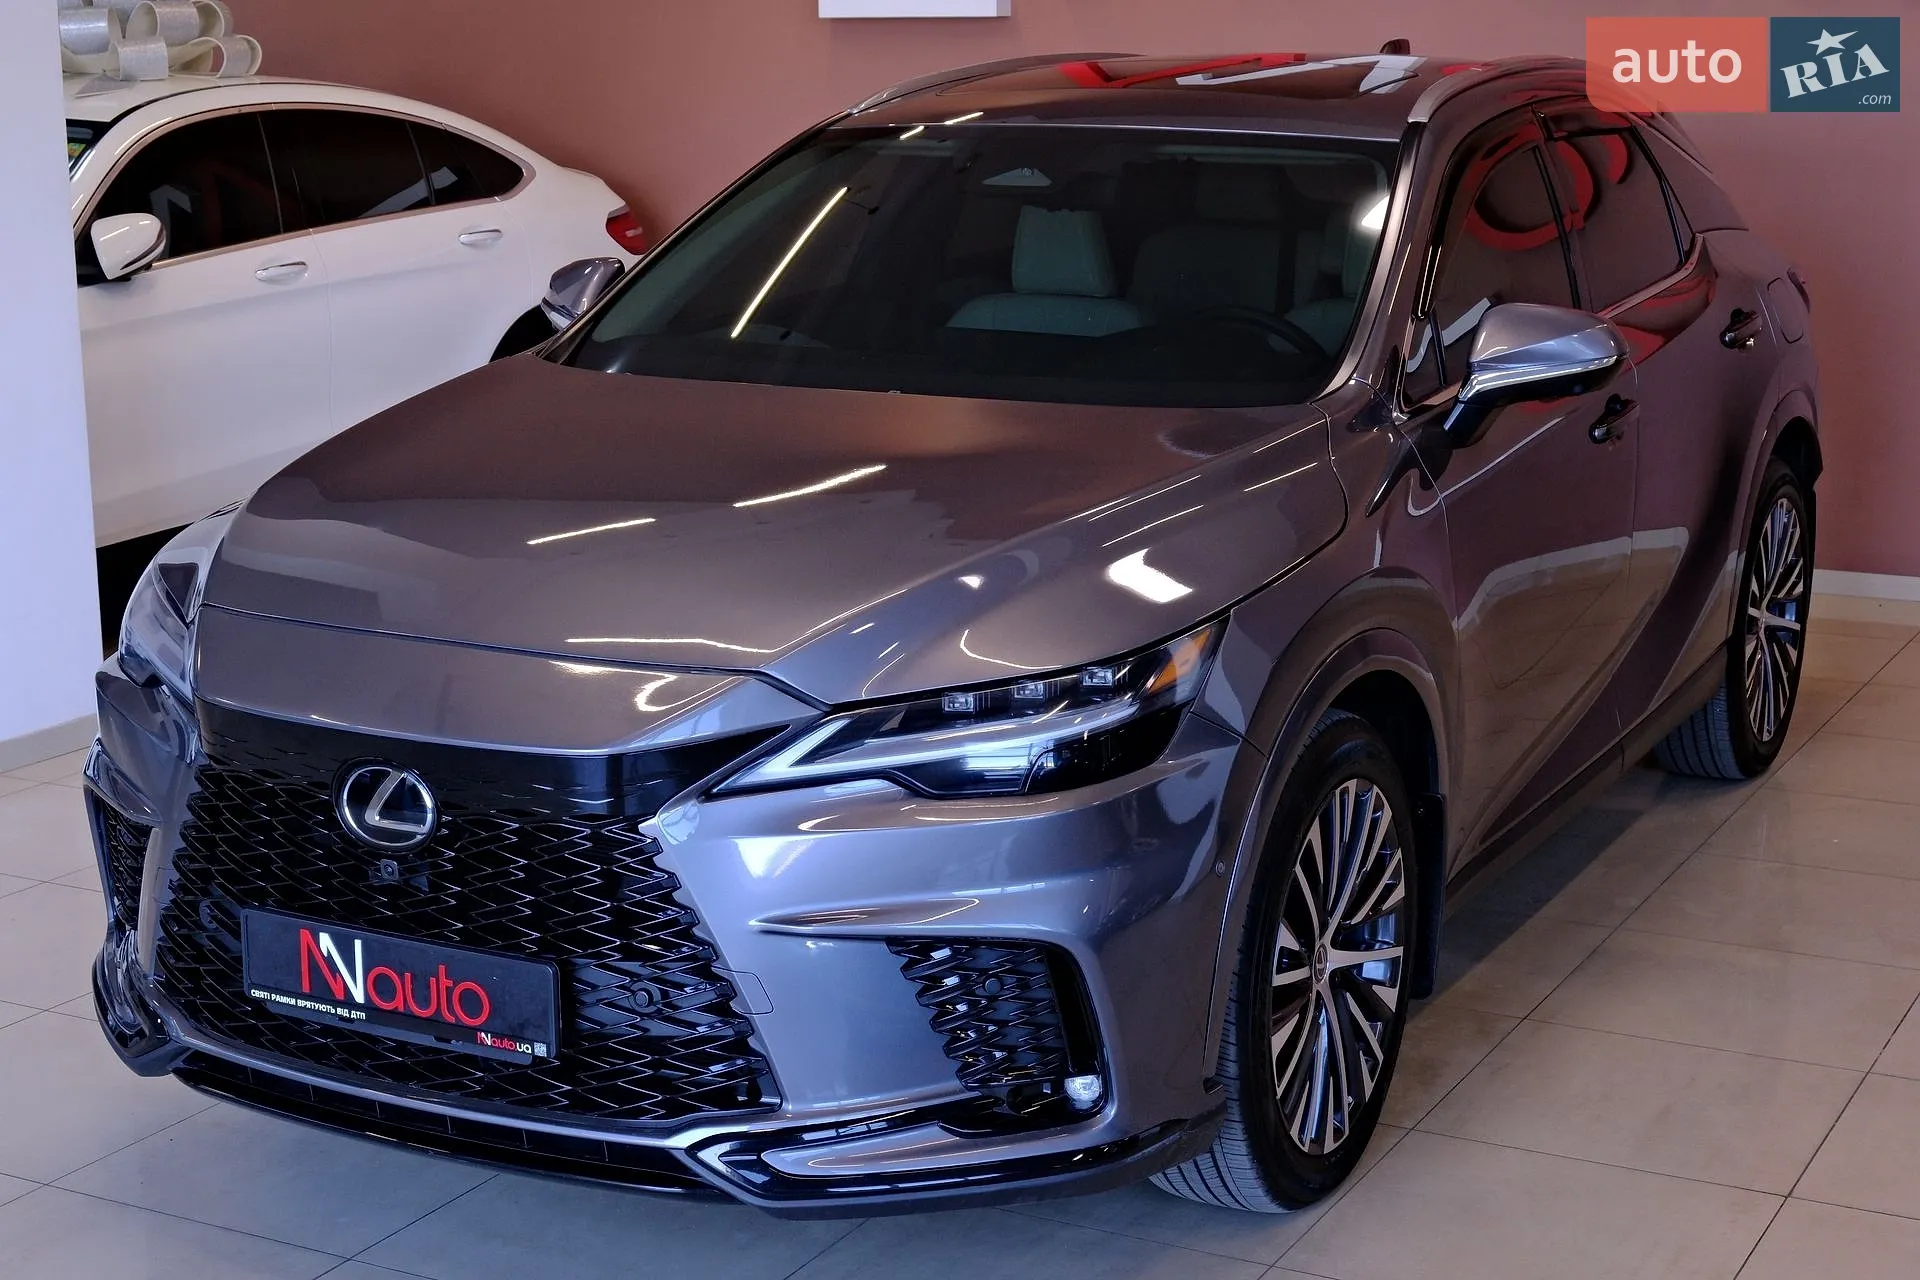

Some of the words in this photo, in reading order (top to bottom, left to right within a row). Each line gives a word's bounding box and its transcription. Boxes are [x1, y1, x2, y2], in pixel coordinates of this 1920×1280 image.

[250, 989, 271, 1000] СВЯТІ
[271, 993, 296, 1006] РАМКИ
[297, 999, 336, 1014] ВРЯТУЮТЬ
[336, 1007, 350, 1018] ВІД
[350, 1010, 366, 1020] ДТП
